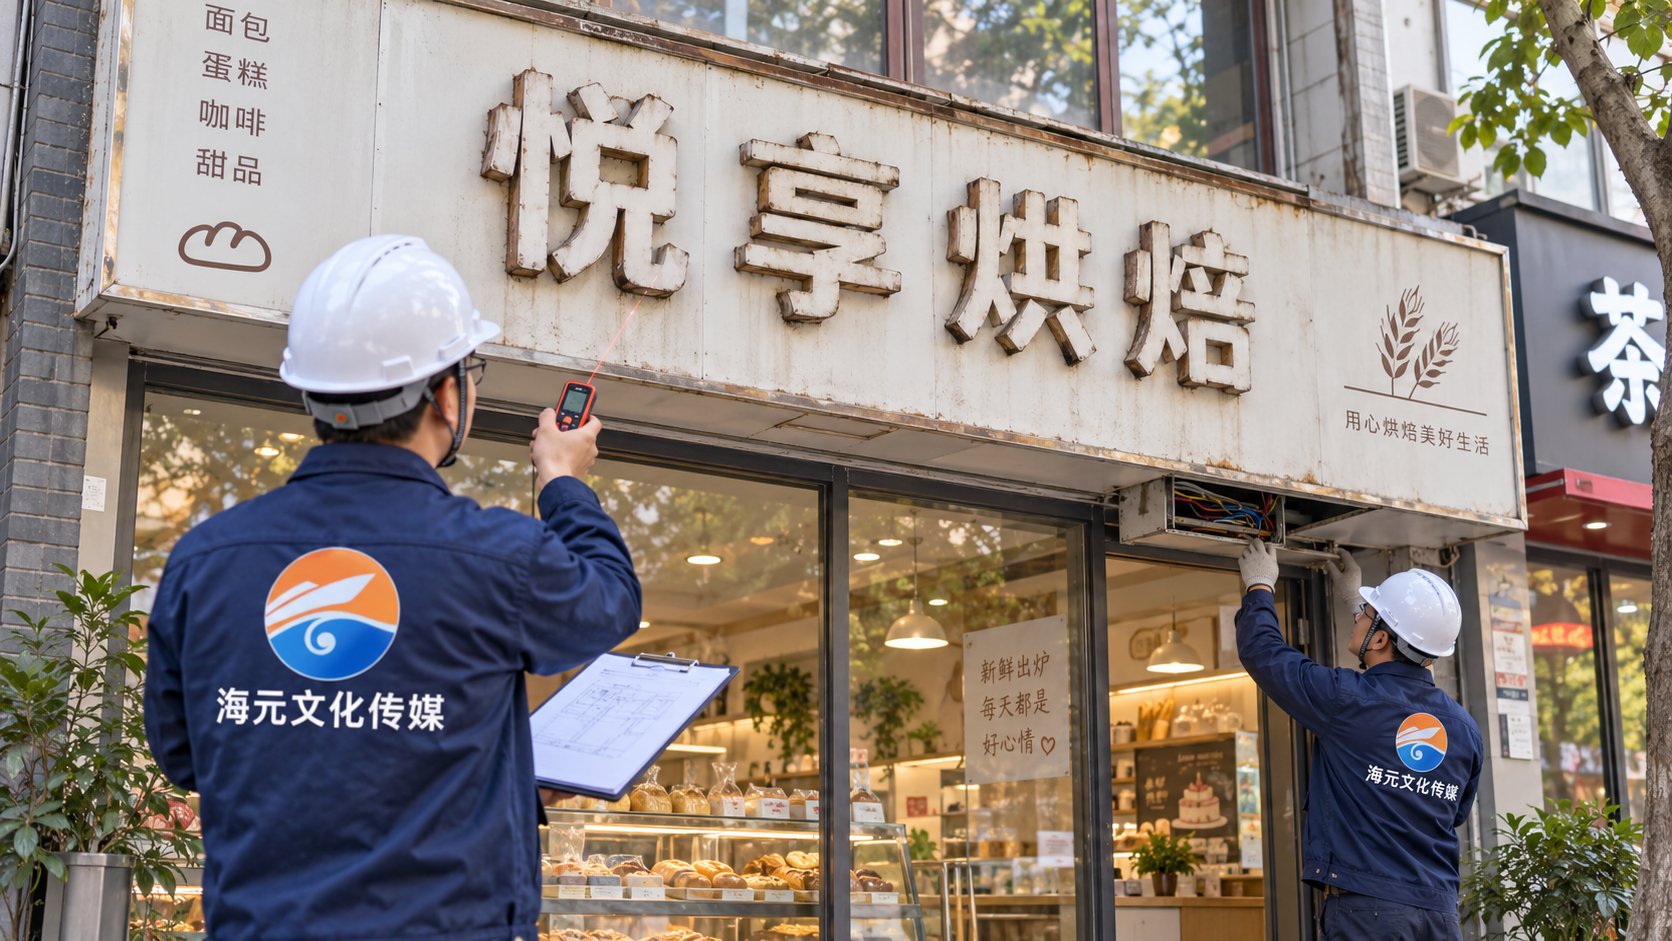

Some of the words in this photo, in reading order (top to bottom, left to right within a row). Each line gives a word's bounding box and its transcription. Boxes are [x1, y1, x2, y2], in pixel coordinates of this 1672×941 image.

[205, 4, 270, 43] 面包
[202, 51, 268, 90] 蛋糕
[199, 99, 266, 137] 咖啡
[197, 149, 262, 186] 甜品
[480, 67, 1255, 395] 悦享烘焙
[1583, 276, 1666, 424] 茶
[1345, 410, 1489, 456] 用心烘焙美好生活
[980, 650, 1050, 684] 新鲜出炉
[216, 687, 445, 732] 海元文化传媒
[980, 688, 1050, 721] 每天都是
[983, 727, 1035, 757] 好心情
[1365, 764, 1459, 801] 海元文化传媒
